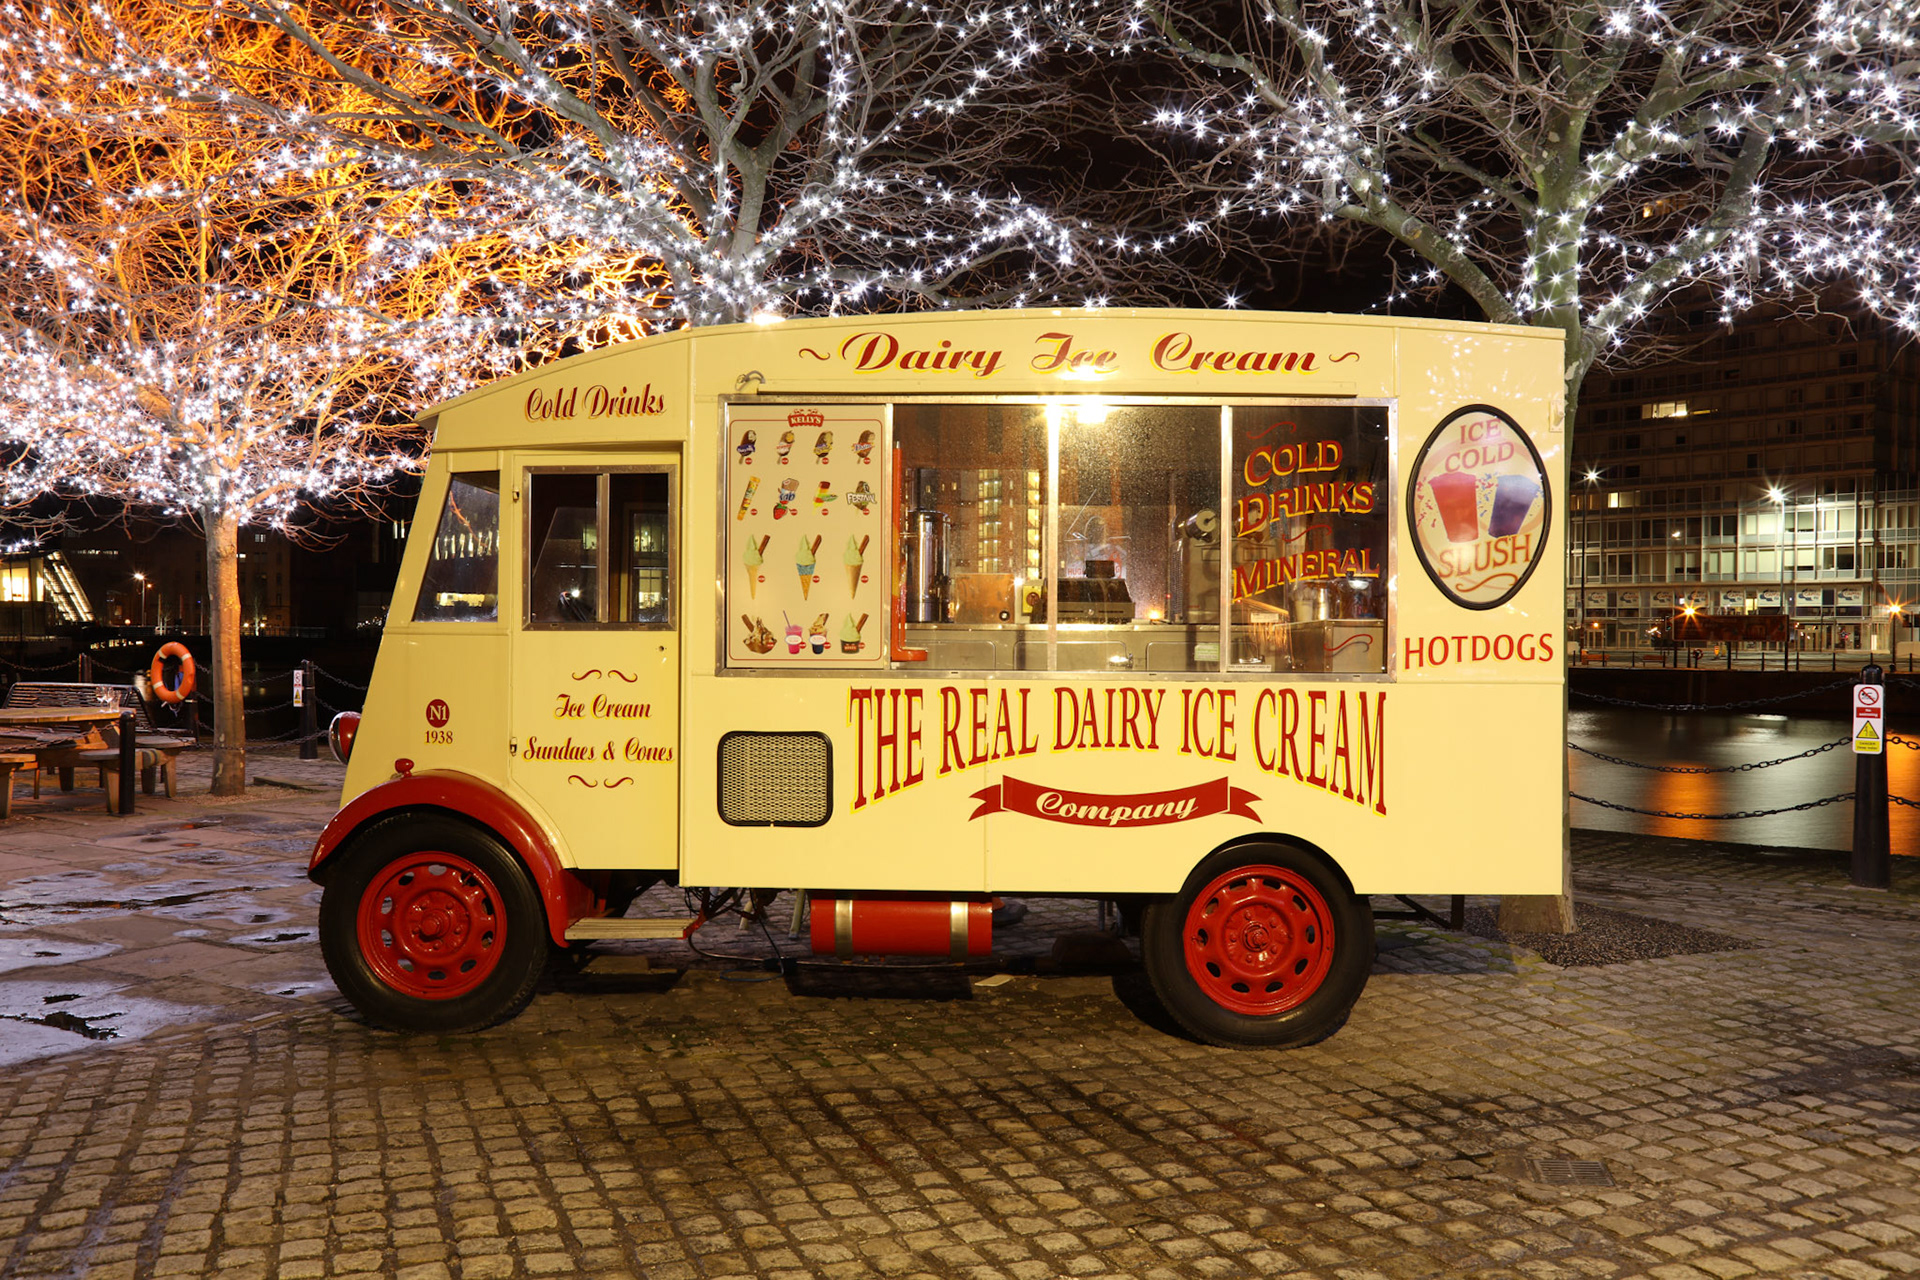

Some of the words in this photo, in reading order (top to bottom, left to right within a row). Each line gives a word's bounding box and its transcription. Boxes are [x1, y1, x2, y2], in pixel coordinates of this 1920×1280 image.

[841, 332, 1006, 377] Dairy
[1031, 332, 1119, 374] Ice
[1151, 332, 1320, 374] Cream
[526, 386, 578, 421] Cold
[584, 383, 666, 418] Drinks
[790, 416, 821, 425] KELLY'S
[1460, 419, 1501, 444] ICE
[1244, 440, 1343, 486] COLD
[1444, 441, 1515, 473] COLD
[1237, 482, 1375, 538] DRINKS
[1438, 533, 1531, 579] SLUSH
[1232, 549, 1380, 603] MINERAL
[1403, 633, 1554, 670] HOTDOGS
[429, 705, 447, 721] N1
[554, 693, 586, 719] Ice
[591, 693, 651, 719] Cream
[425, 730, 453, 744] 1938
[523, 736, 596, 762] Sundaes
[602, 740, 616, 762] &
[624, 737, 675, 762] Cones
[848, 687, 924, 813] THE
[937, 686, 1039, 775] REAL
[1052, 687, 1166, 753] DAIRY
[1178, 688, 1237, 762] ICE
[1253, 688, 1387, 817] CREAM
[1035, 791, 1199, 826] Company
